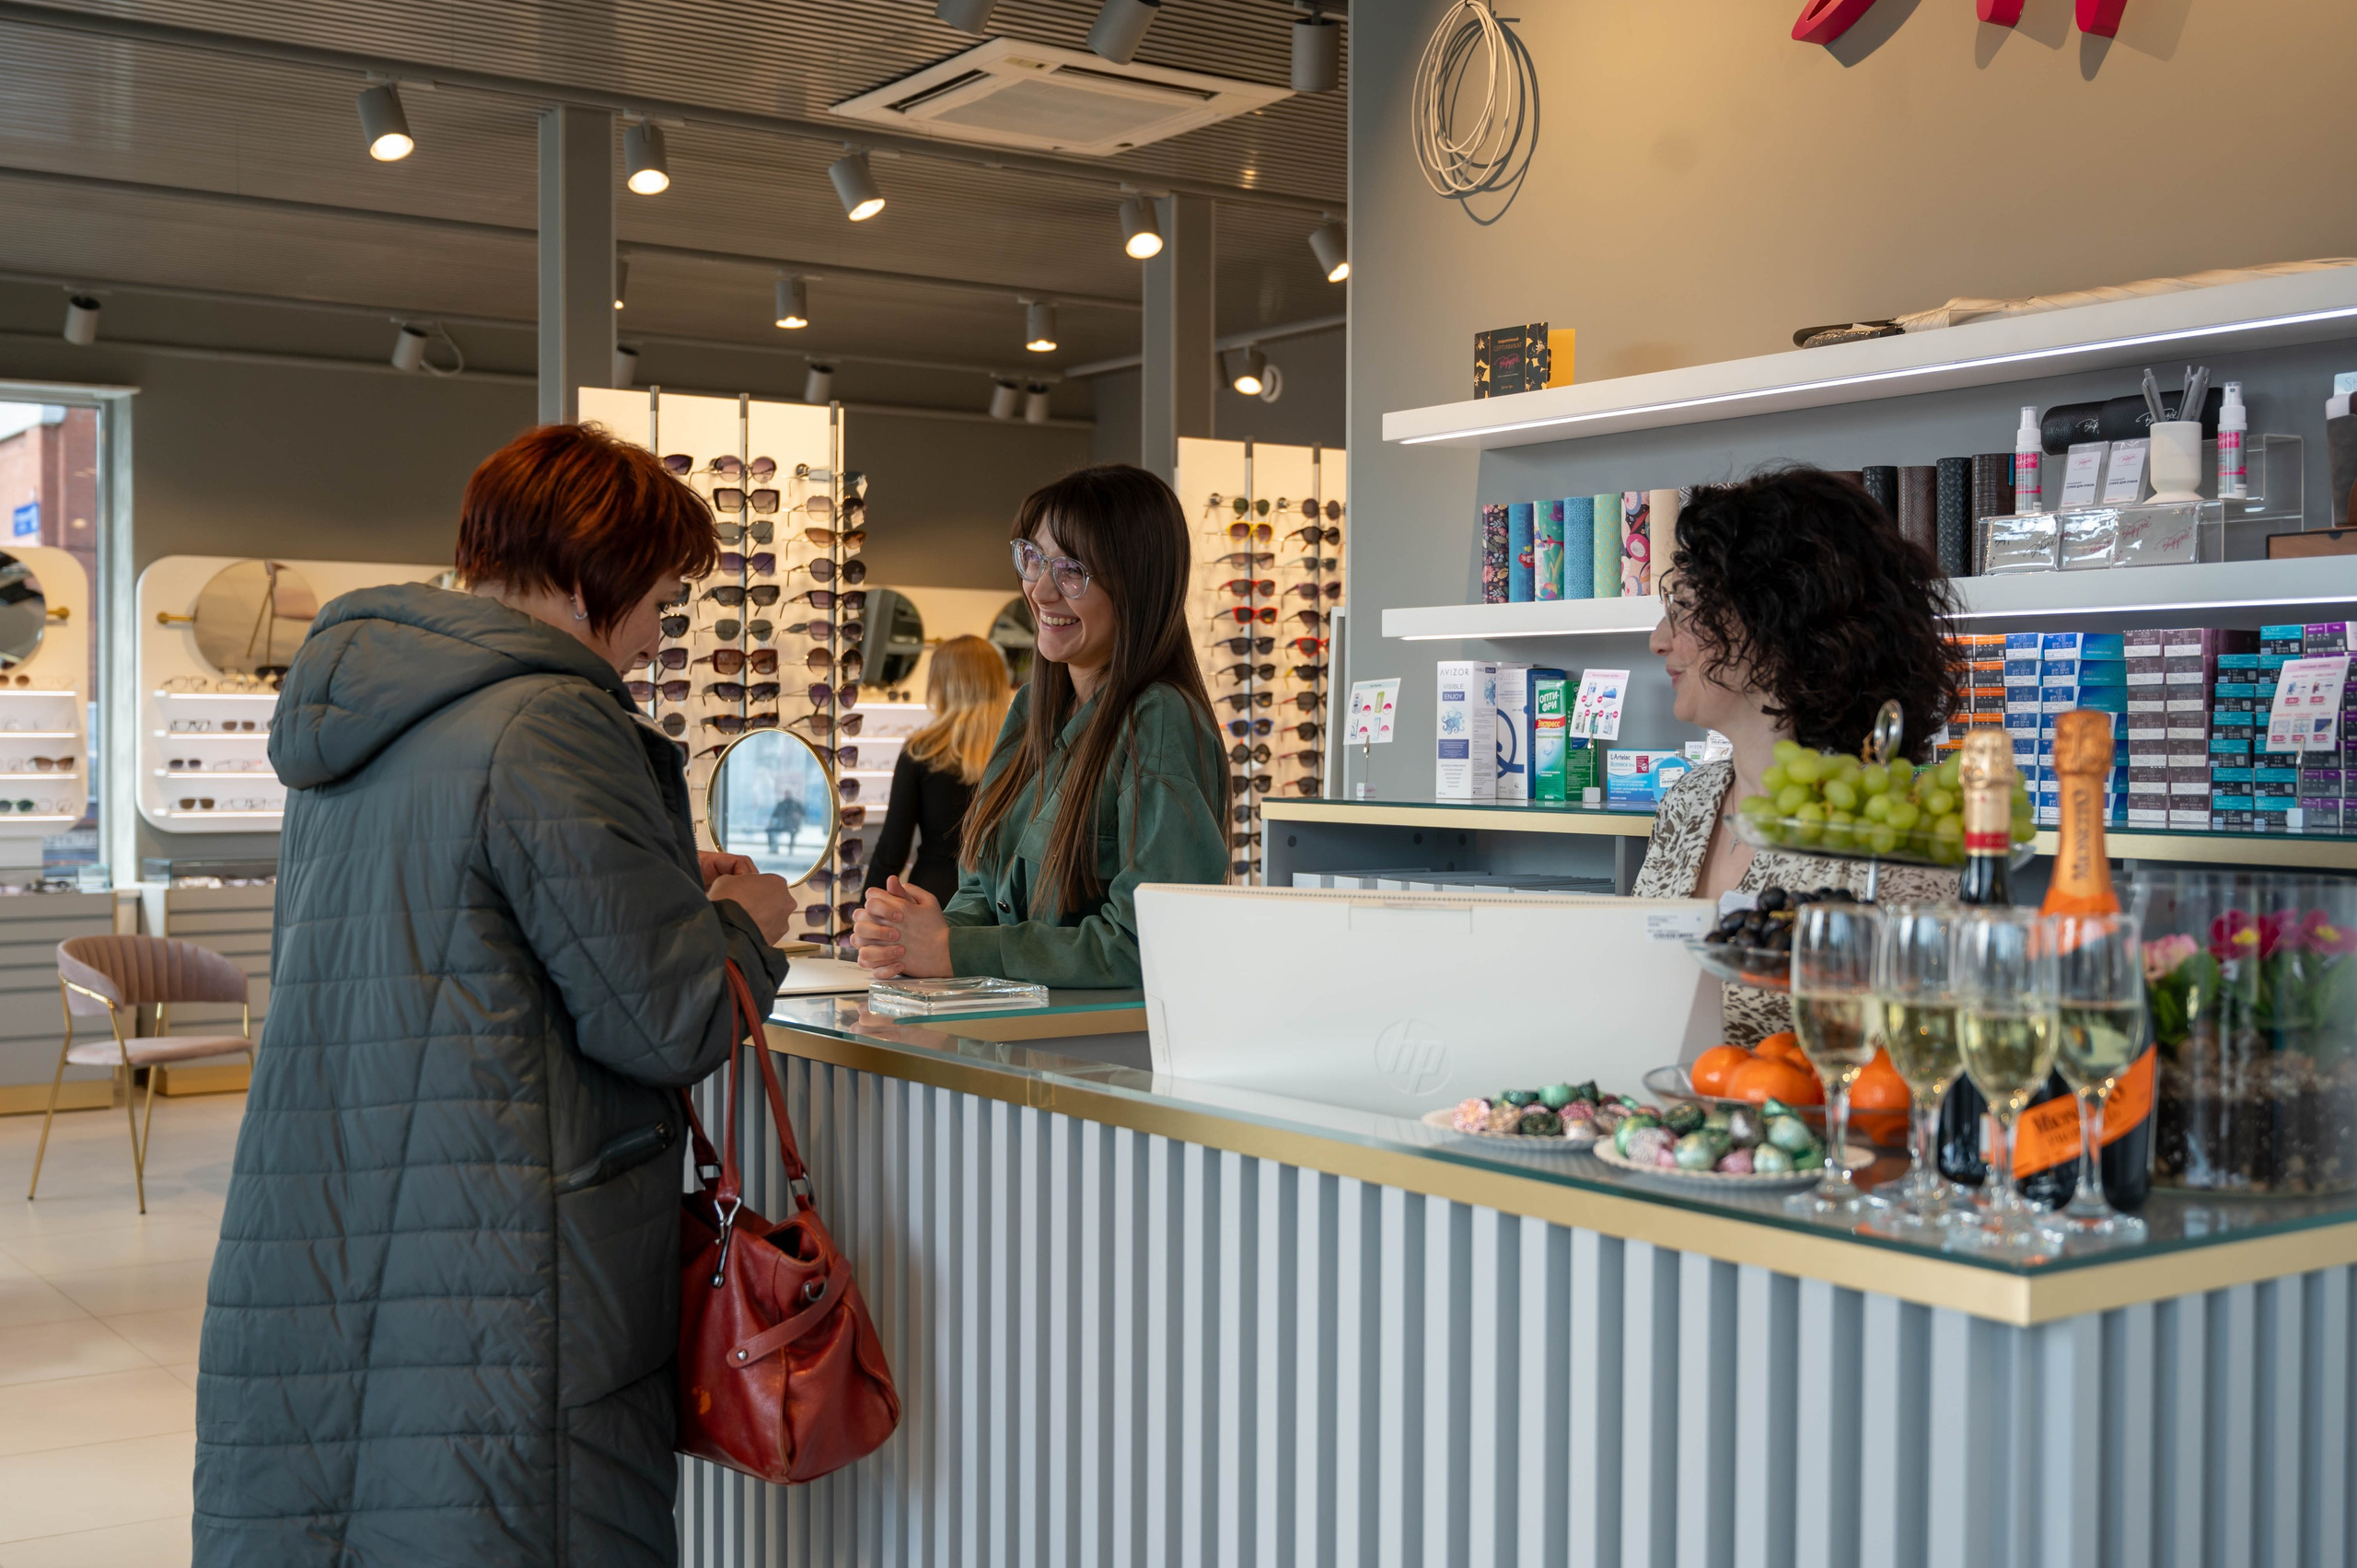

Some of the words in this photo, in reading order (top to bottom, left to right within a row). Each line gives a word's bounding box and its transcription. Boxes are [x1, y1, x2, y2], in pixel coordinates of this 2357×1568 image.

[1493, 342, 1523, 352] СЕРТИФИКАТ
[1539, 691, 1560, 703] ОПТИ-
[1542, 701, 1557, 712] ФРИ
[1538, 720, 1561, 728] Экспресс
[1387, 1018, 1446, 1094] hp
